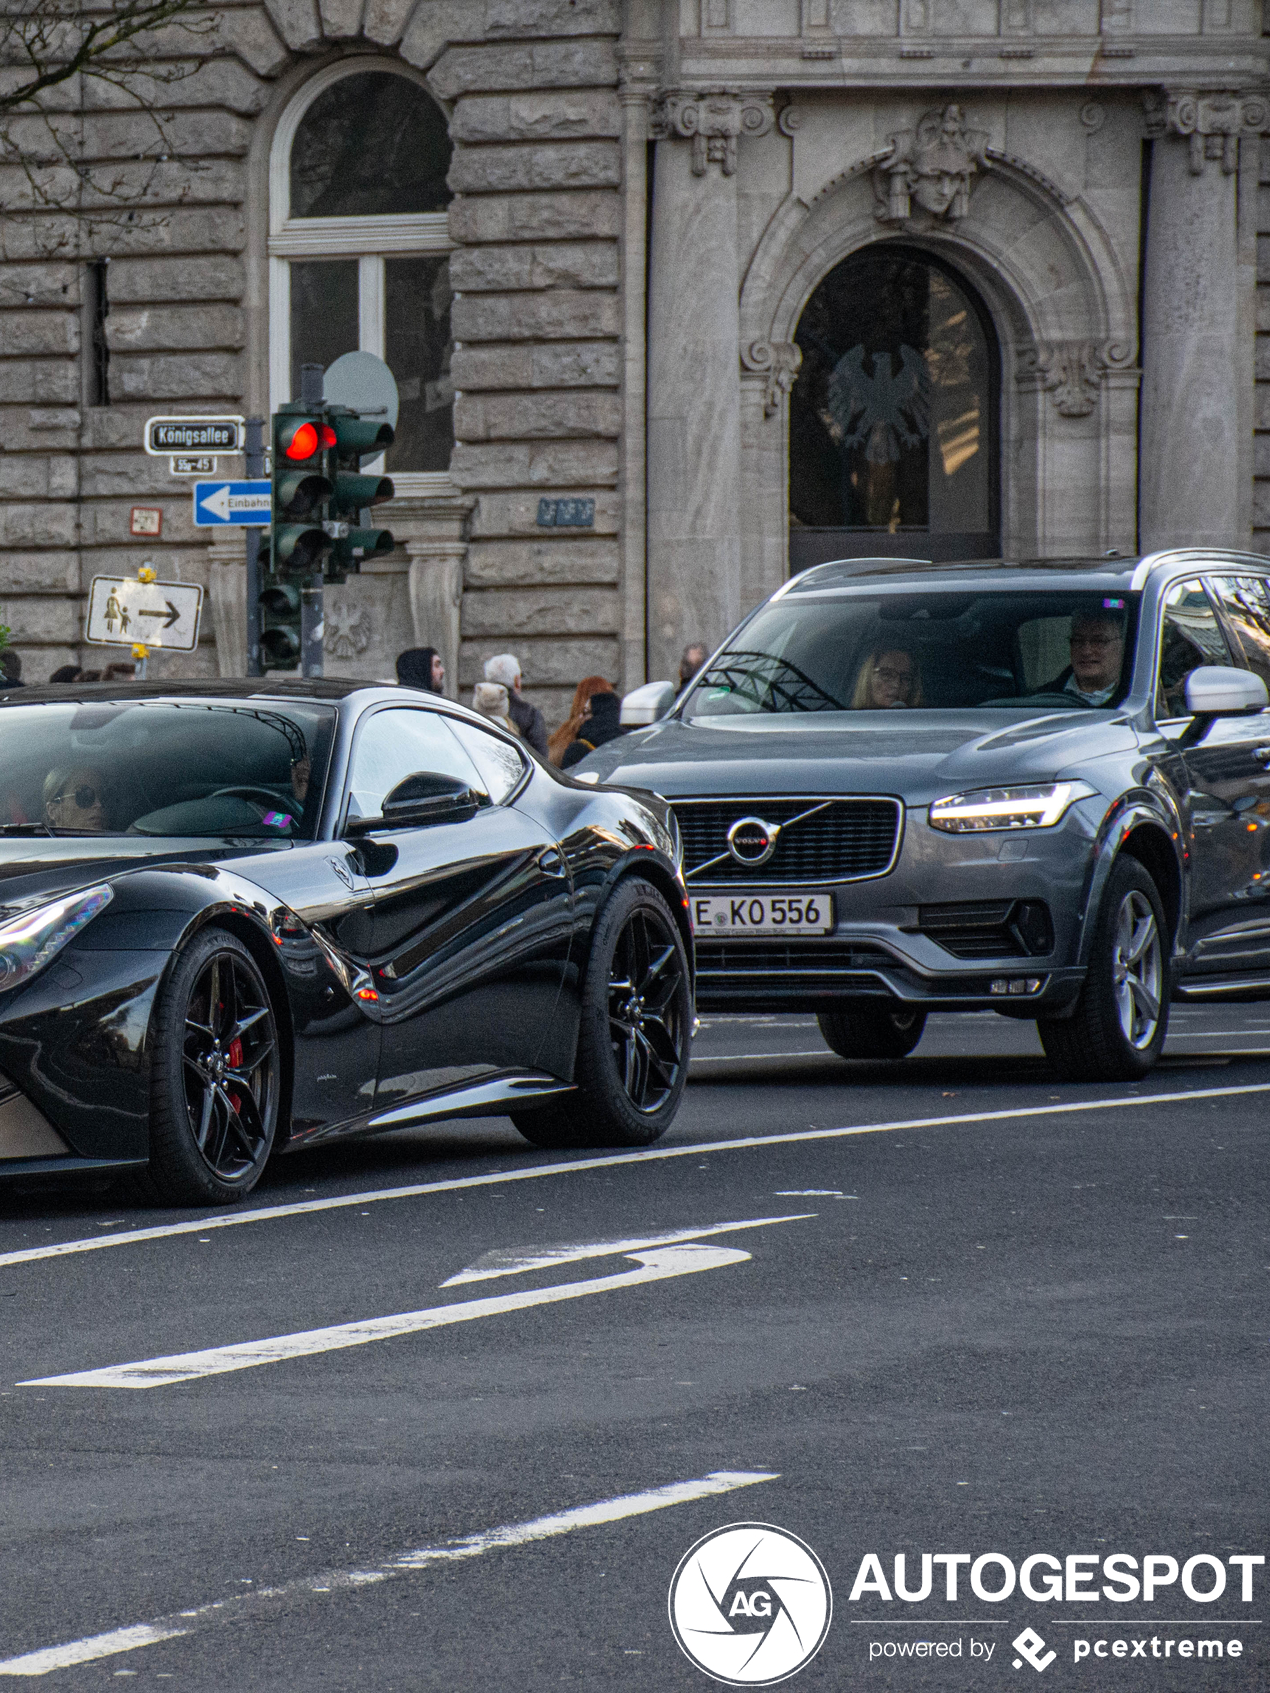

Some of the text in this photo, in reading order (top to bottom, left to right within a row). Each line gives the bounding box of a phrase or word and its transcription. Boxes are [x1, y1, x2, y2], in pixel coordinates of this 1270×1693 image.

[158, 427, 229, 446] Königsallee
[227, 498, 270, 508] Einbahn
[695, 900, 712, 925] E
[731, 899, 765, 925] KO
[771, 898, 820, 924] 556
